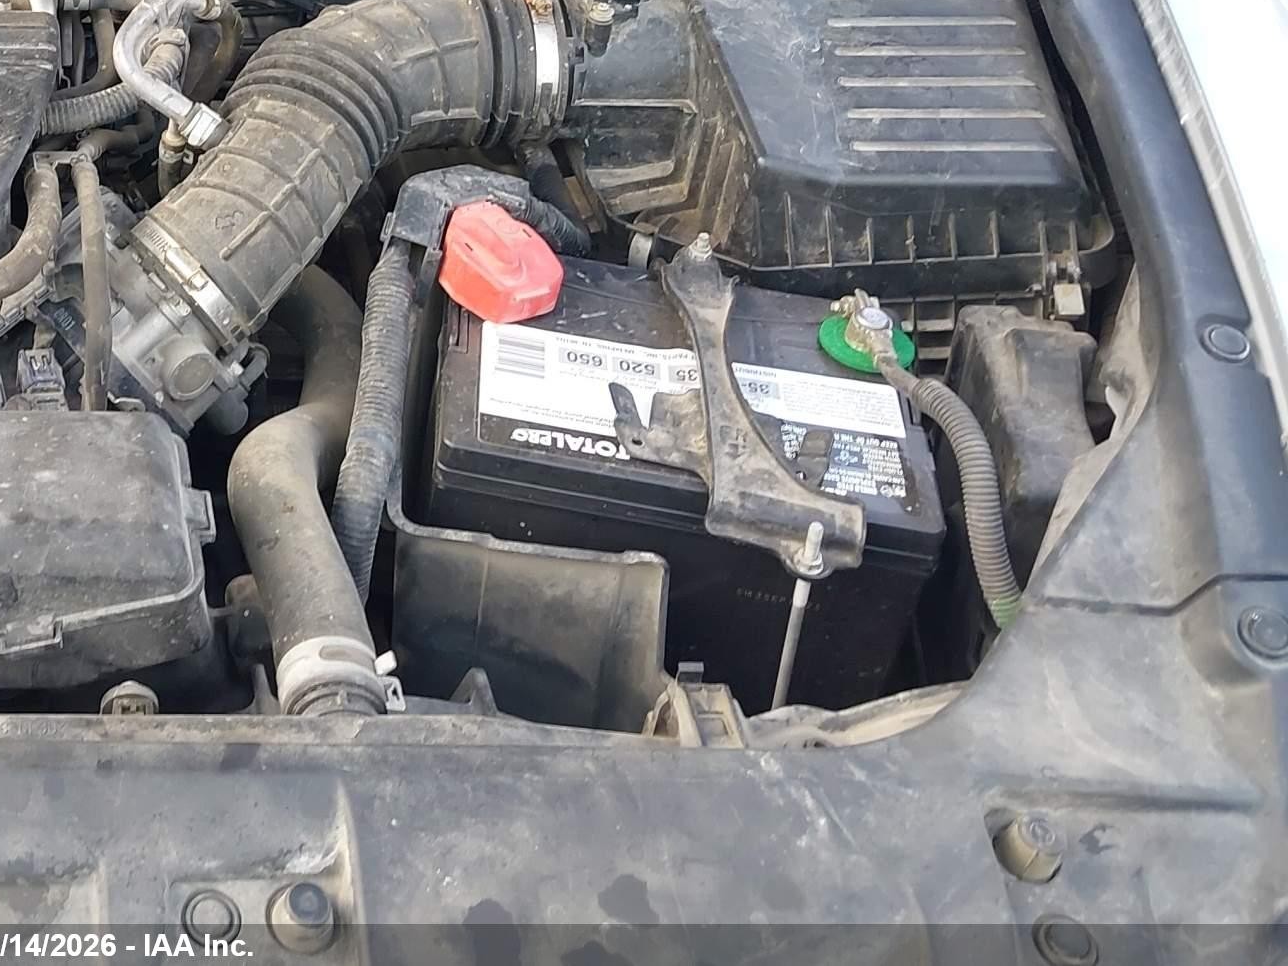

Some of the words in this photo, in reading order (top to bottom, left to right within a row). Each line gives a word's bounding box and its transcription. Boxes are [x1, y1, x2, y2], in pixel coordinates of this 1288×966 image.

[567, 350, 603, 368] 650
[619, 359, 655, 376] 520
[676, 368, 698, 382] 35
[510, 427, 631, 460] TOTALPRO
